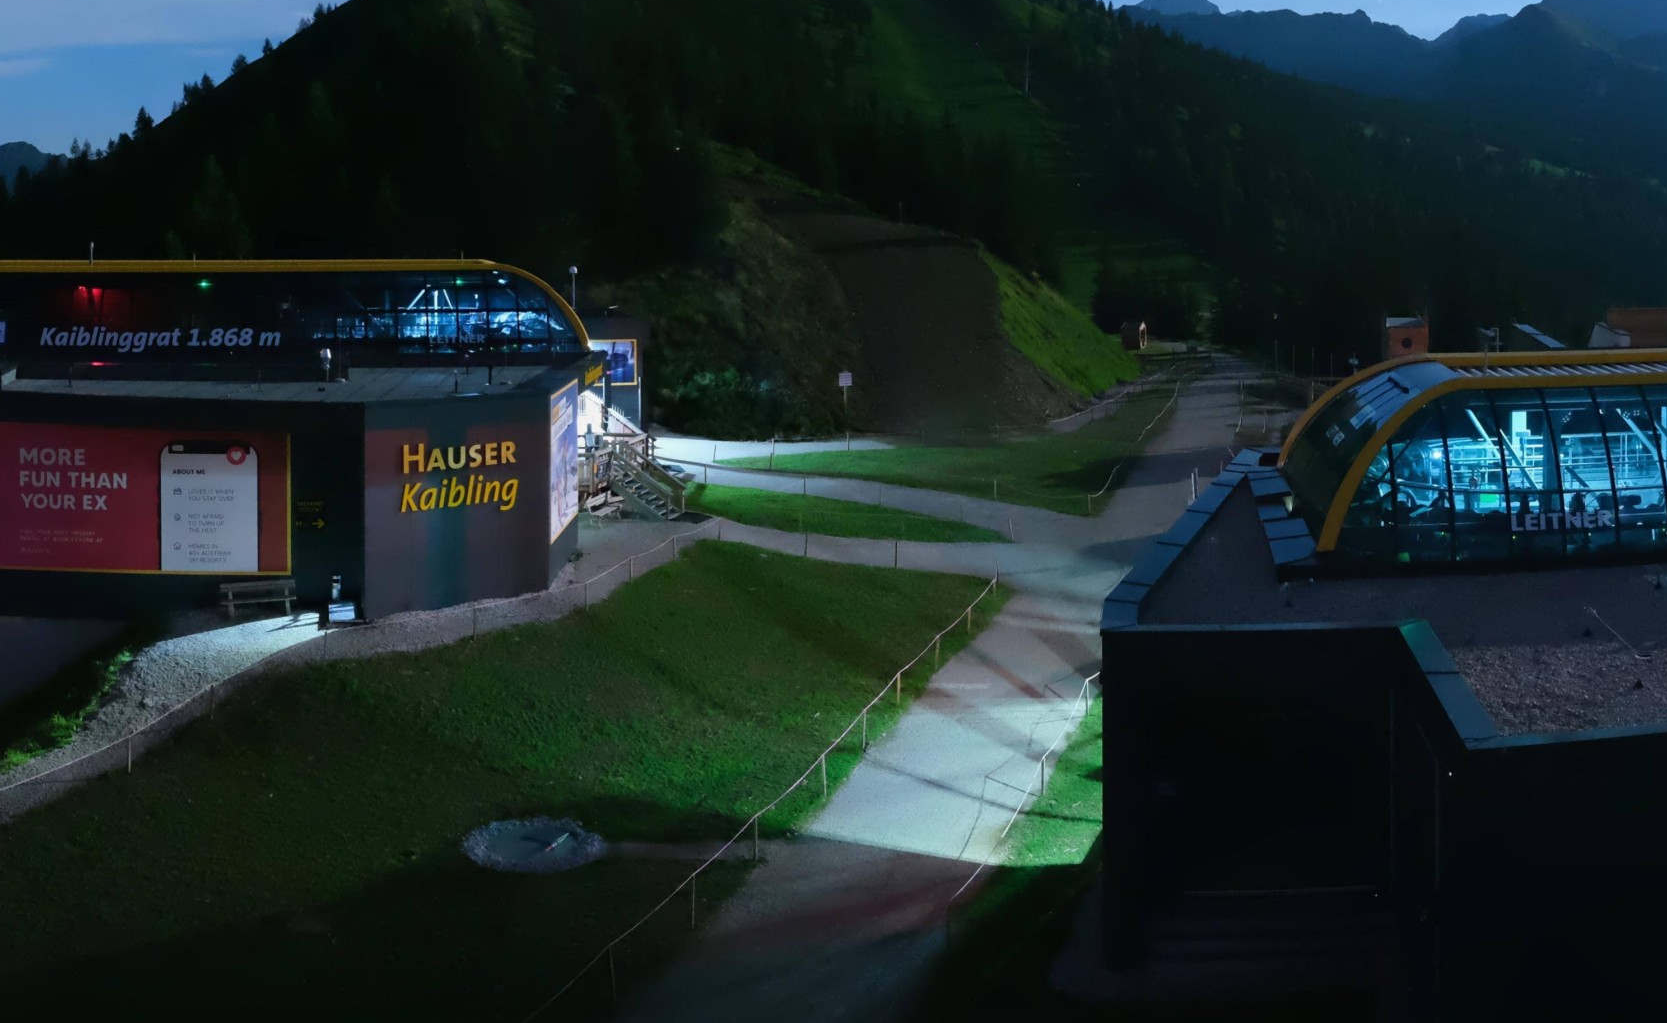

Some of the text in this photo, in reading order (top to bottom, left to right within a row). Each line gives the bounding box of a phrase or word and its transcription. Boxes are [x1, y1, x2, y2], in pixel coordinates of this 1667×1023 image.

[39, 326, 282, 353] Kaiblinggrat 1.868 m
[428, 334, 486, 344] LEITNER
[19, 447, 86, 466] MORE
[402, 441, 517, 474] HAUSER
[19, 470, 128, 489] FUN THAN
[20, 493, 108, 511] YOUR EX
[400, 474, 519, 513] Kaibling
[1511, 509, 1612, 532] LEITNER
